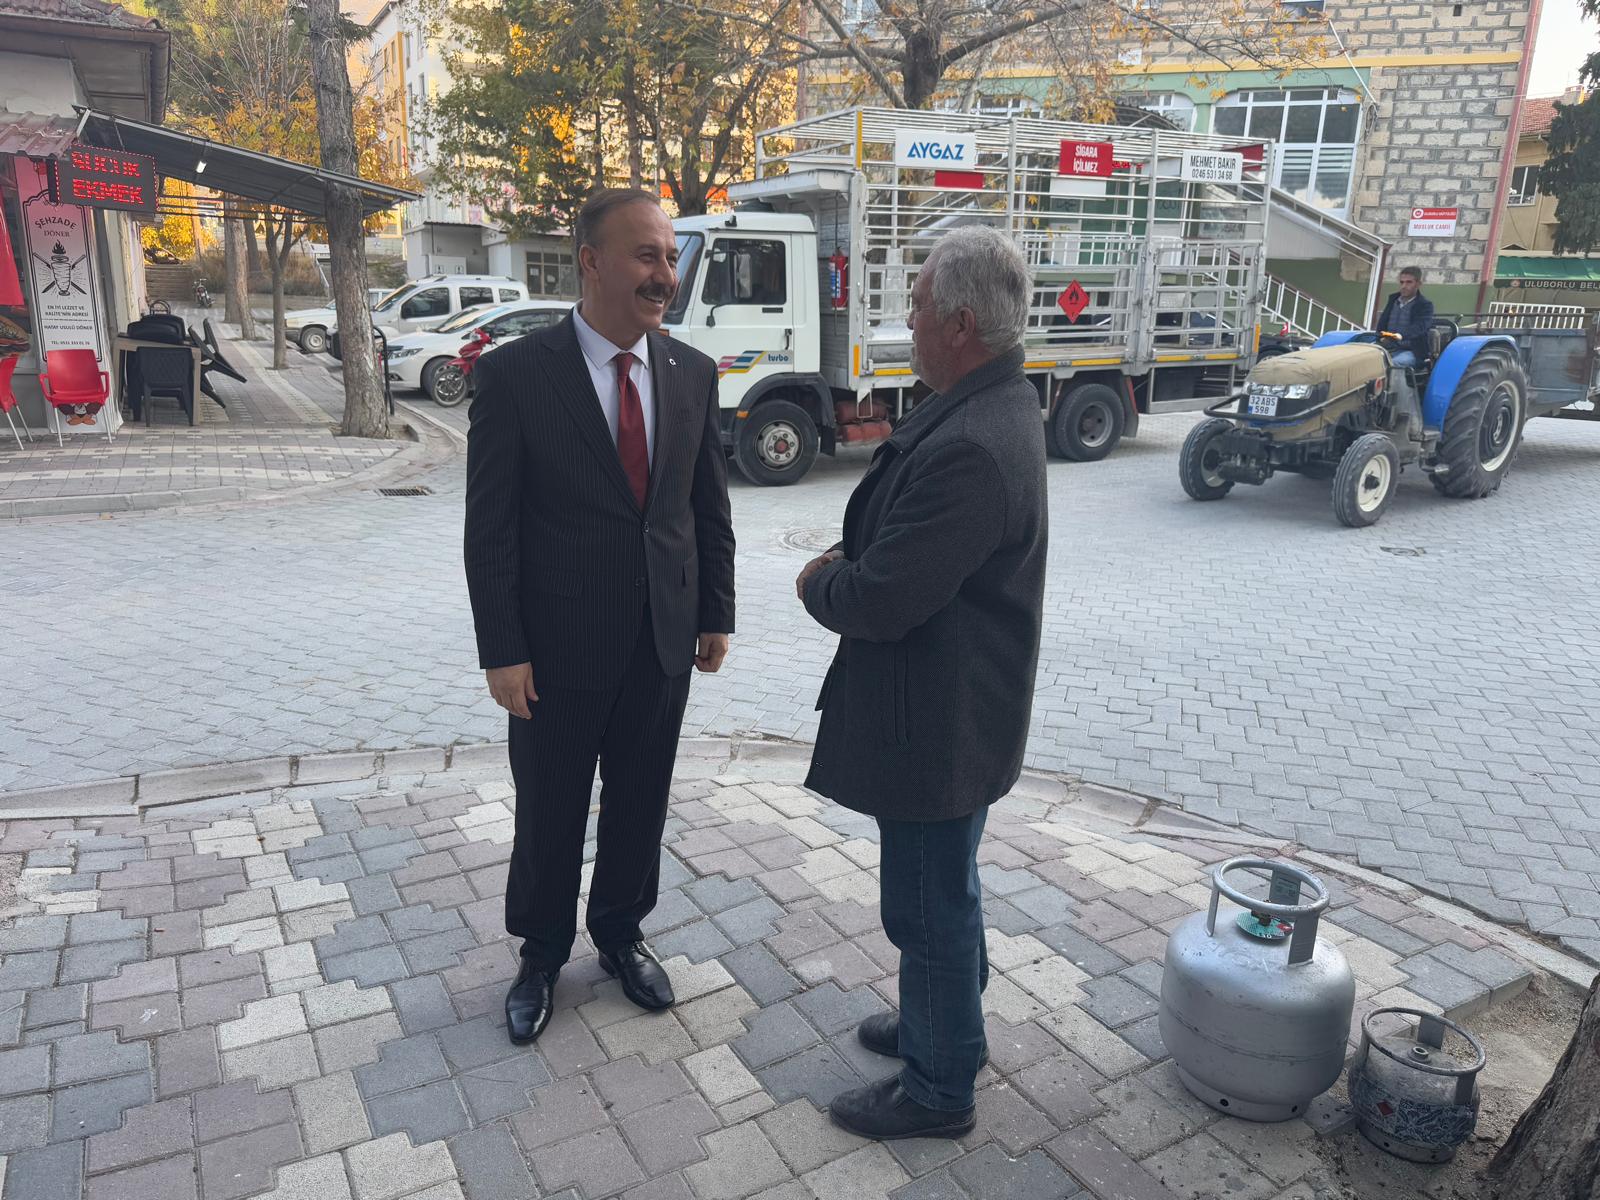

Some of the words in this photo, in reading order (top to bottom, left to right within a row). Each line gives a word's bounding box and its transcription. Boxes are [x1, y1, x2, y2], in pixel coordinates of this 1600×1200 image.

[907, 142, 964, 160] AYGAZ
[1075, 144, 1098, 158] SİGARA
[1073, 158, 1098, 173] İÇİLMEZ
[1190, 155, 1216, 169] MEHMET
[1217, 158, 1236, 170] BAKIR
[1192, 169, 1206, 179] 0246
[1206, 170, 1217, 180] 531
[1217, 170, 1225, 180] 34
[72, 178, 144, 204] EKMEK
[35, 216, 77, 230] ŞEHZADE
[1255, 405, 1269, 414] 598
